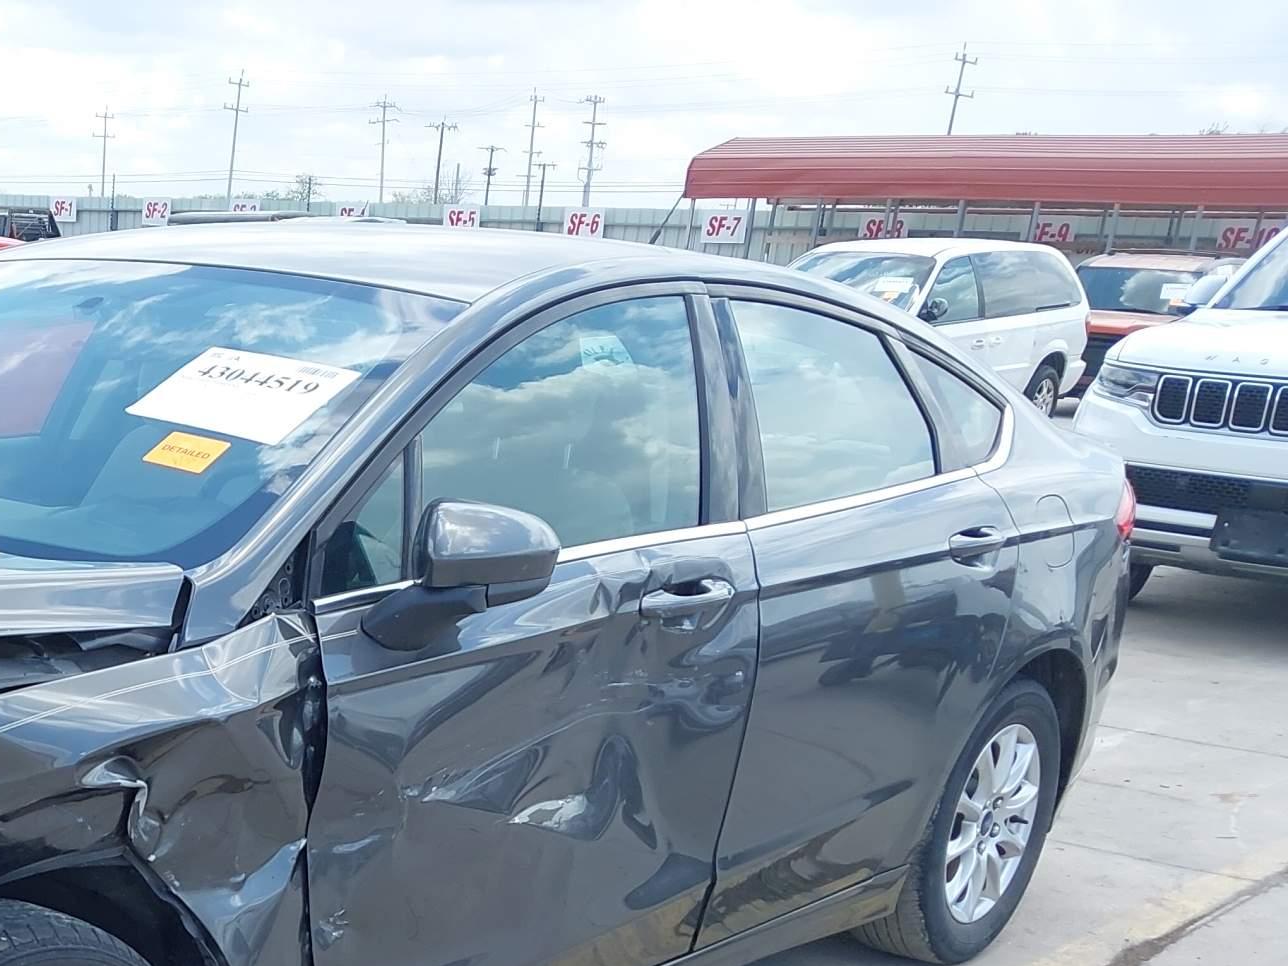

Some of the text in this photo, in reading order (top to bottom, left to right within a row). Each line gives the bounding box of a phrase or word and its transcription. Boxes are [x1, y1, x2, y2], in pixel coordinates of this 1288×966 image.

[53, 200, 73, 217] SF-1
[145, 201, 168, 219] SF-2
[567, 212, 601, 236] SF-6
[706, 215, 743, 238] SF-7
[196, 364, 320, 395] 43044519
[161, 443, 211, 460] DETAILED
